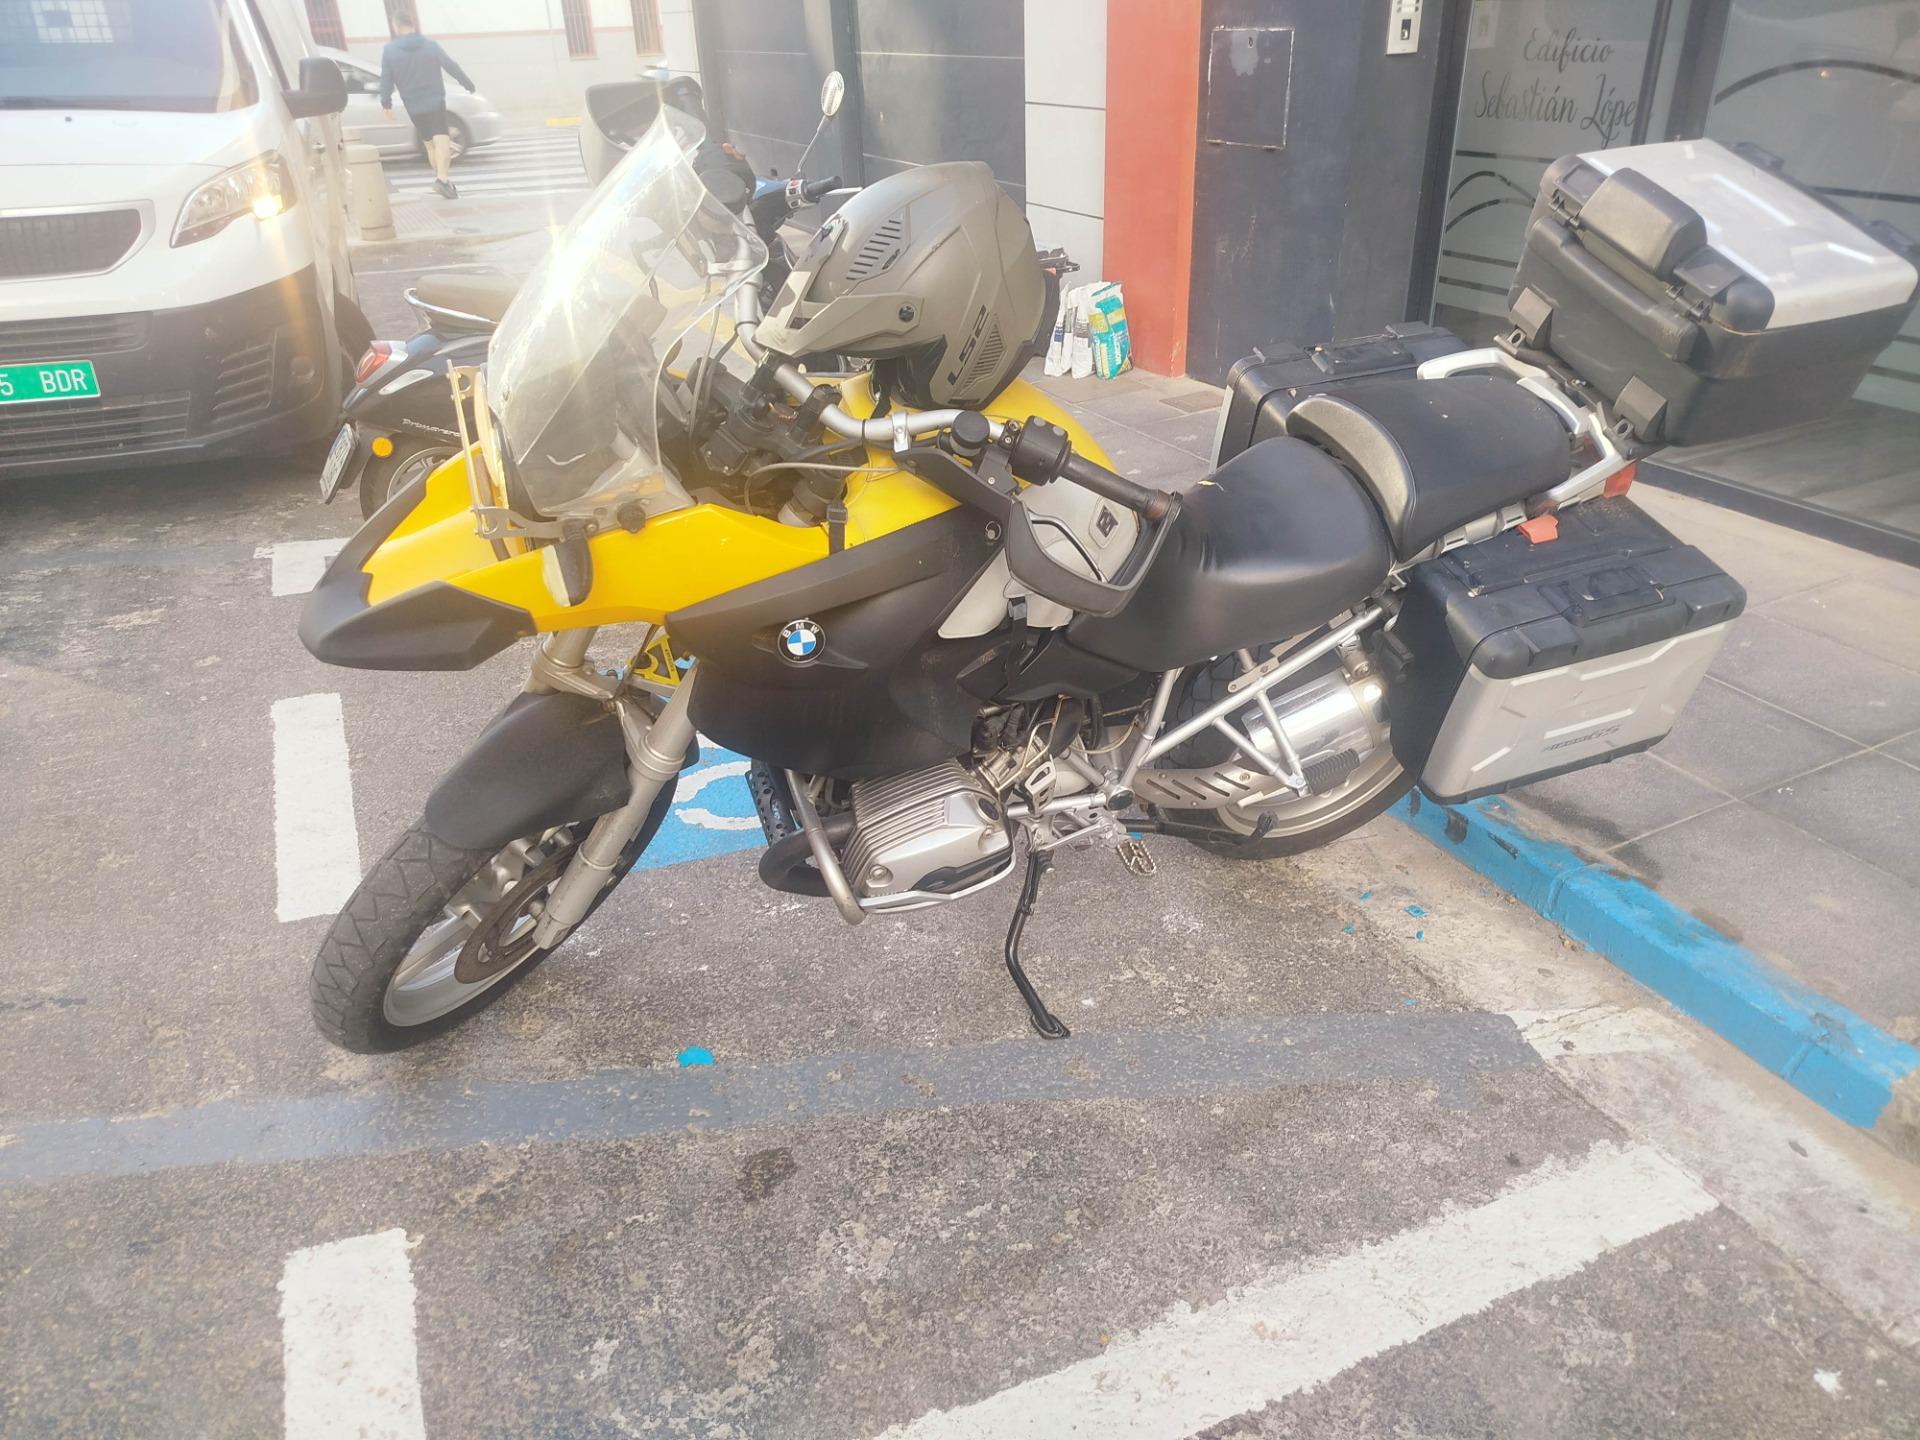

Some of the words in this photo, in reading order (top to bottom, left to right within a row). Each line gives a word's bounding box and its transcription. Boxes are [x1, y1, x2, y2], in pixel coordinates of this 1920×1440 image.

[1523, 27, 1615, 72] Edificio
[1474, 70, 1577, 124] Sebastián
[1580, 73, 1638, 149] Lópe
[946, 303, 990, 386] LS2
[40, 368, 88, 393] BDR
[782, 622, 820, 638] BMW
